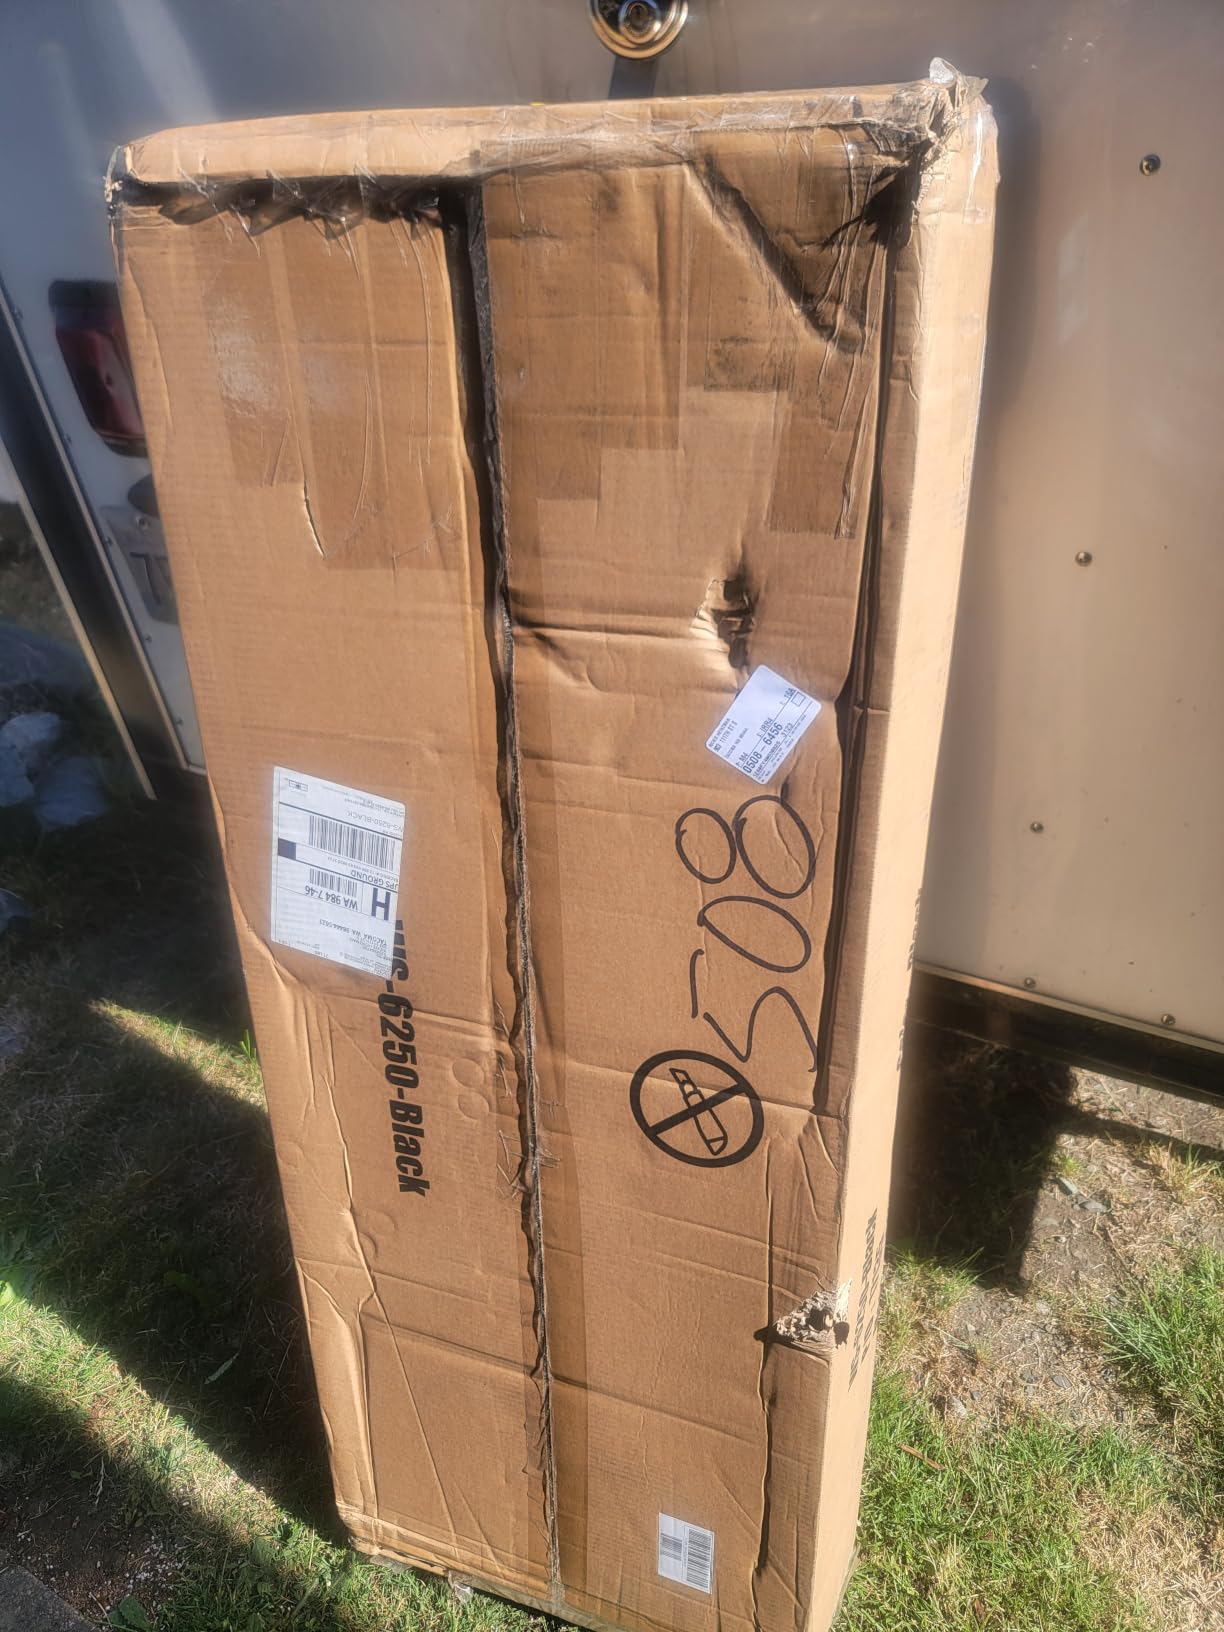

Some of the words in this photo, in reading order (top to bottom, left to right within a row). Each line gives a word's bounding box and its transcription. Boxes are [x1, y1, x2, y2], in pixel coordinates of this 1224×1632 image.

[741, 750, 763, 773] 0508
[761, 721, 783, 745] 6456
[350, 869, 383, 885] GROUND
[325, 891, 340, 903] 984
[343, 897, 357, 909] WA
[371, 887, 390, 921] H
[378, 920, 431, 1198] -6250-Black
